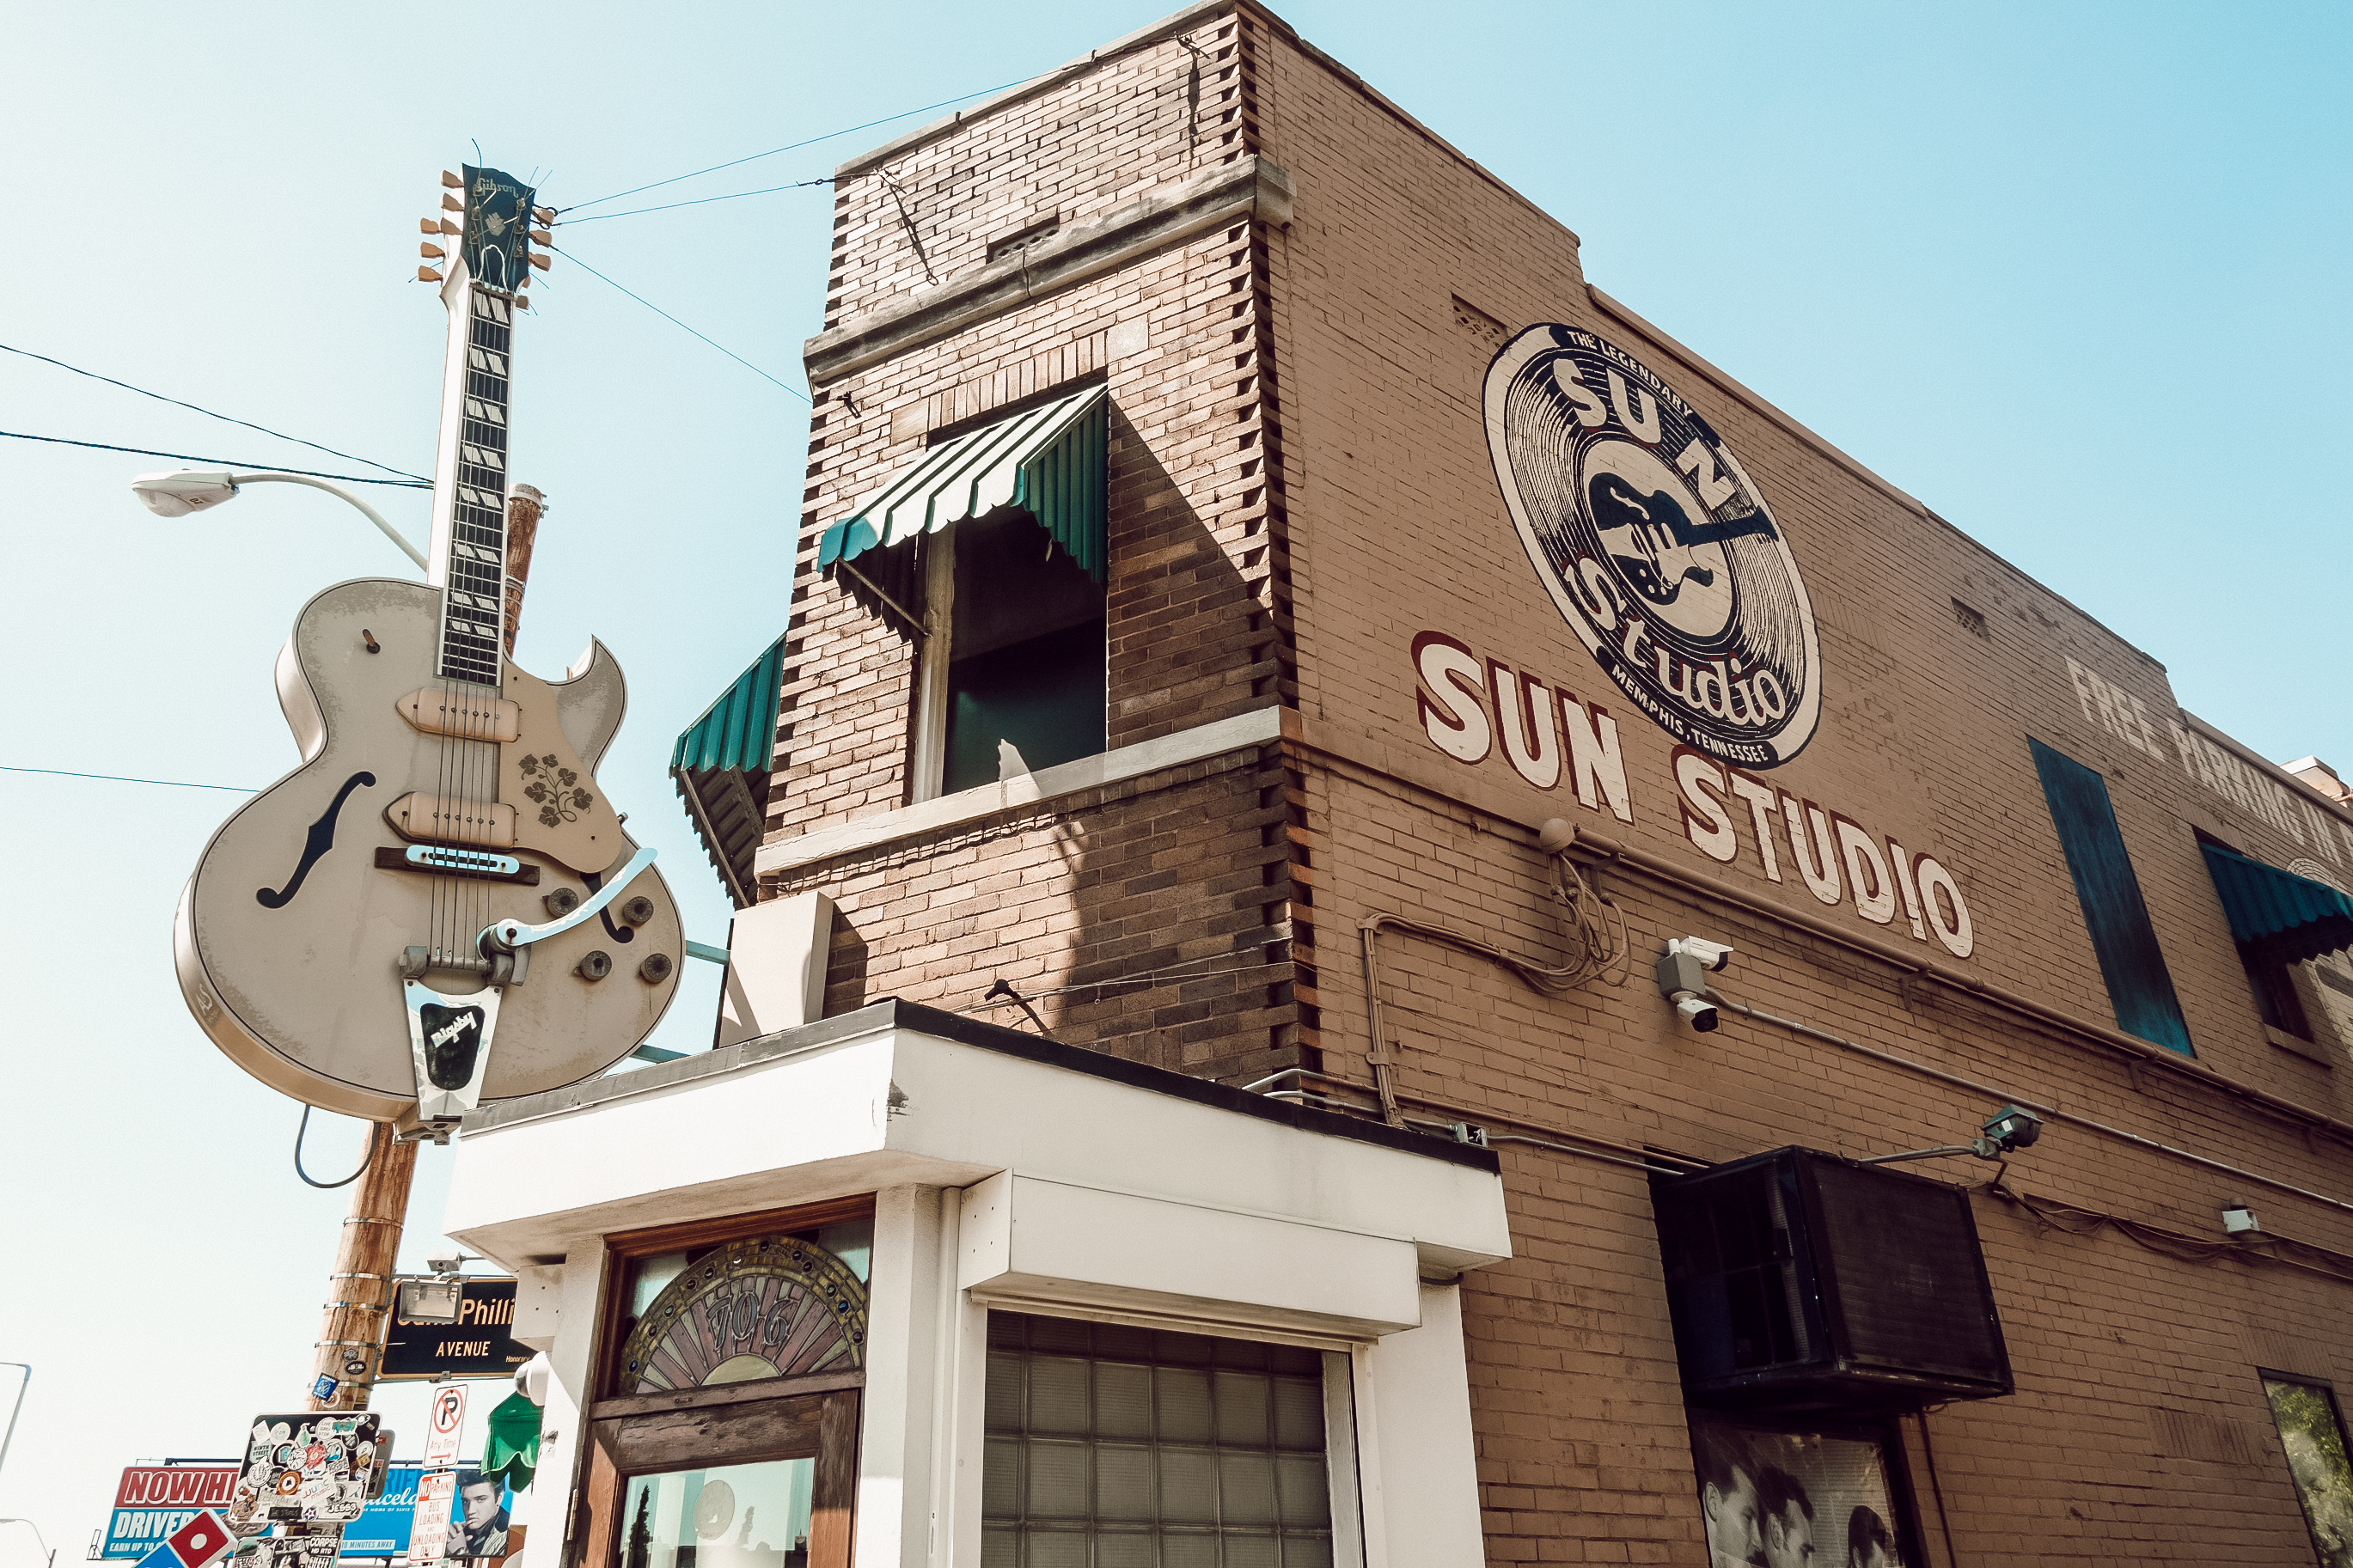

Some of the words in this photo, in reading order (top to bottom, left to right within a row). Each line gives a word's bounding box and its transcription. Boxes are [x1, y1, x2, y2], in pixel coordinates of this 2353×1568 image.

[477, 177, 519, 198] Gibson
[1567, 331, 1598, 350] THE
[1599, 339, 1694, 418] LEGENDARY
[1553, 357, 1737, 511] SUN
[1562, 551, 1787, 727] Studio
[1690, 728, 1769, 763] TENNESSEE
[2064, 655, 2165, 763] FREE
[2167, 717, 2306, 846] PARKING
[2297, 798, 2344, 868] IN
[1411, 631, 1635, 826] SUN
[1672, 744, 1974, 959] STUDIO
[430, 1010, 478, 1048] Bigsby
[706, 1291, 798, 1350] 706
[436, 1340, 491, 1358] AVENUE
[430, 1440, 441, 1451] Any
[443, 1438, 456, 1449] Time
[124, 1471, 205, 1504] NOW
[419, 1480, 431, 1498] NO
[430, 1480, 452, 1494] PARKING
[327, 1503, 357, 1513] JESS3
[428, 1501, 440, 1512] BUS
[419, 1513, 443, 1525] LOADING
[109, 1542, 131, 1552] EARN
[131, 1542, 144, 1552] UP
[144, 1542, 155, 1552] TO
[309, 1537, 339, 1547] CORPSE
[413, 1532, 445, 1546] UNLOADING
